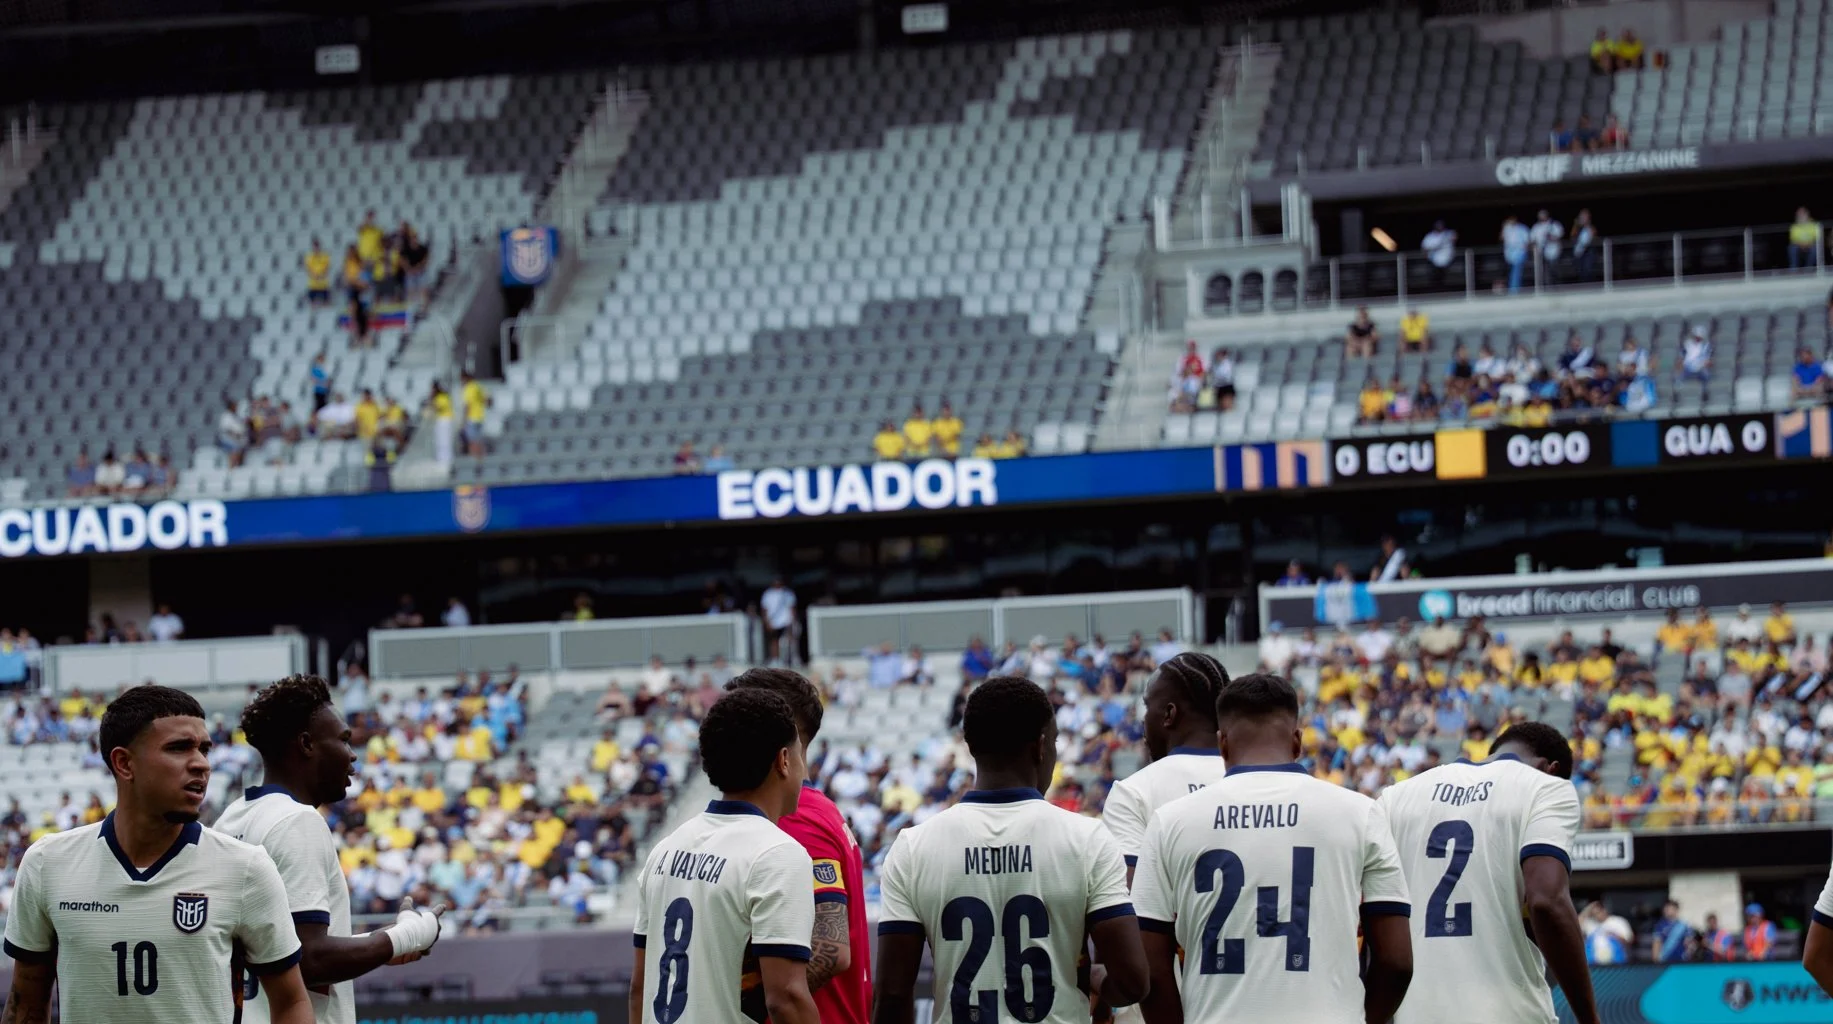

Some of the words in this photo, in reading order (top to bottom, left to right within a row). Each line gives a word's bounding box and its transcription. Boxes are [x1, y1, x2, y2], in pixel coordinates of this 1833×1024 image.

[1581, 147, 1698, 176] MEZZANINE
[1507, 431, 1590, 467] 0:00
[1742, 420, 1767, 452] 0
[1335, 444, 1360, 476] 0
[1366, 440, 1434, 474] ECU
[717, 457, 998, 520] ECUADOR
[0, 501, 228, 557] CUADOR
[1534, 583, 1635, 613] financial
[1643, 584, 1700, 609] CLUB
[1431, 781, 1493, 806] TORRES
[1213, 803, 1299, 830] AREVALO
[965, 845, 1033, 875] MEDINA
[1424, 819, 1474, 938] 2
[59, 900, 119, 913] marathon
[1194, 846, 1315, 974] 24
[111, 940, 158, 996] 10
